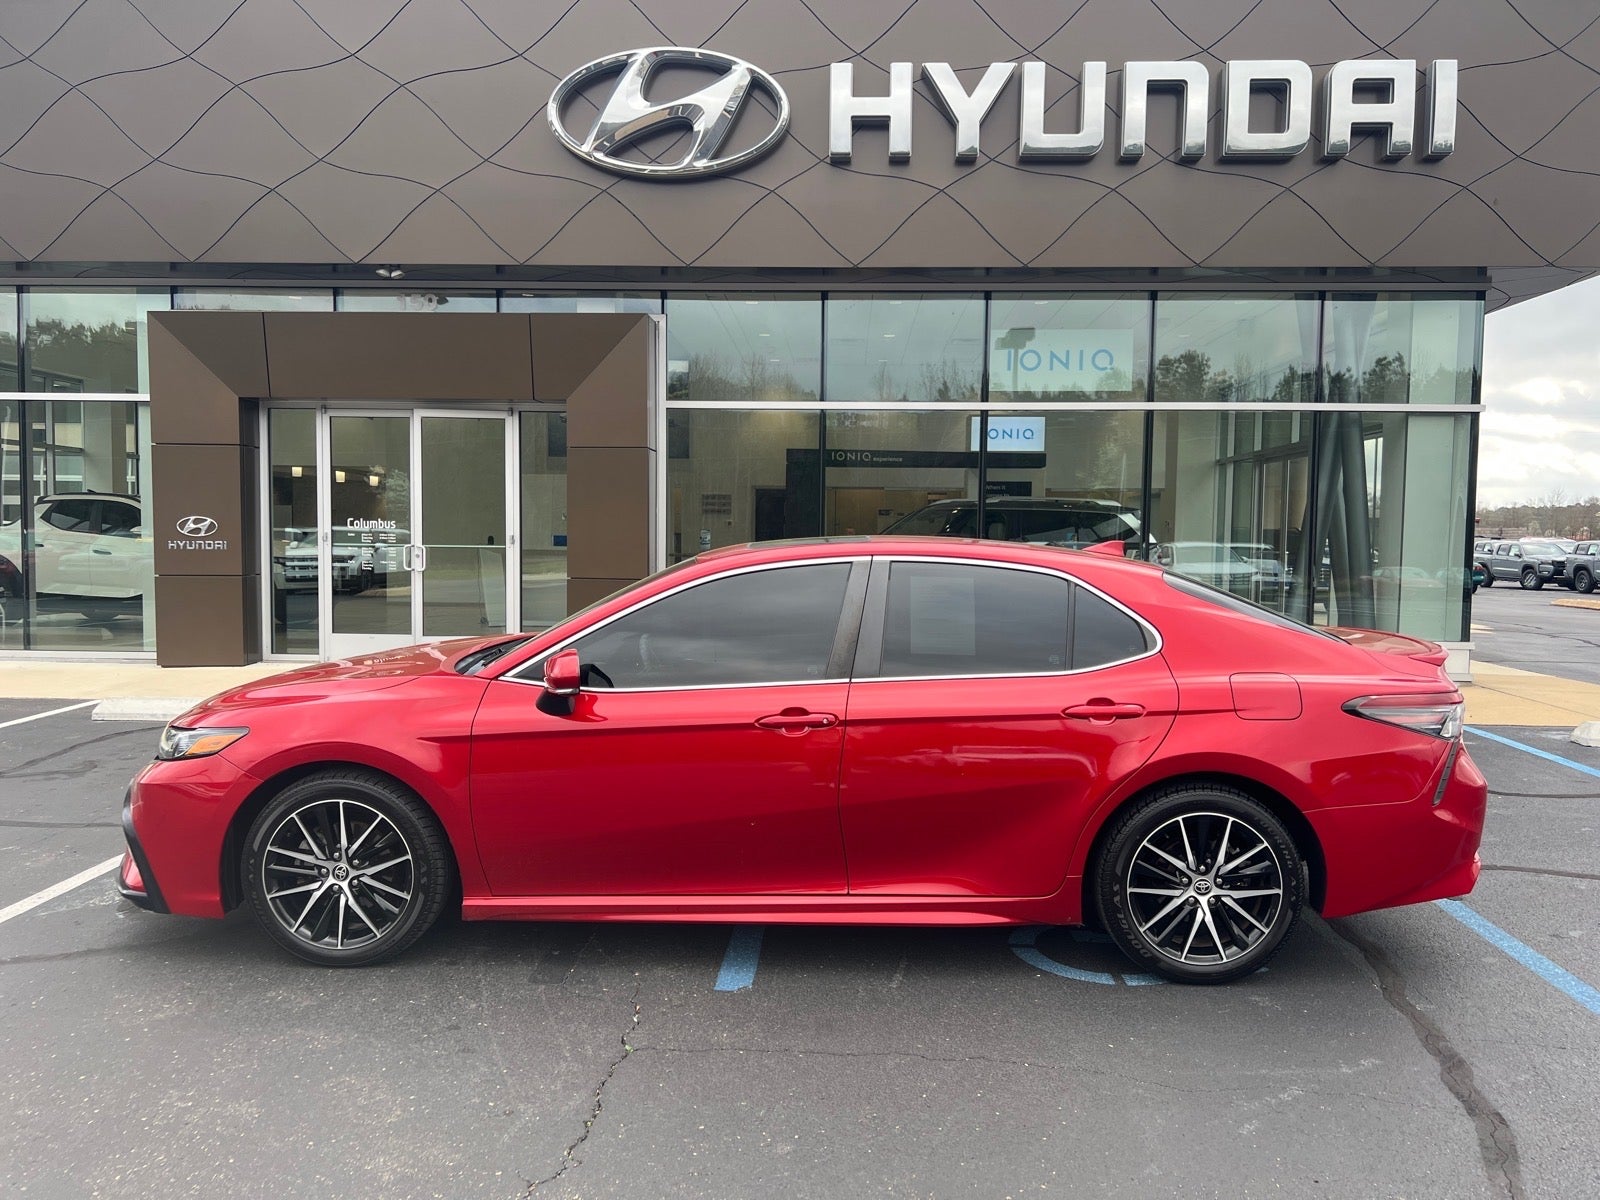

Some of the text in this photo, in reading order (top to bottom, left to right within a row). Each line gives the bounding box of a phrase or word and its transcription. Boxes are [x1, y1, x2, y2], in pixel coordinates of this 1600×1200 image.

[828, 59, 1459, 162] HYUNDAI
[1006, 349, 1115, 372] IONIQ
[987, 428, 1035, 440] ONIQ
[831, 451, 872, 462] IONIQ
[346, 517, 397, 529] Columbus
[167, 540, 228, 550] HYUNDAI
[1112, 882, 1153, 958] DOUGLAS
